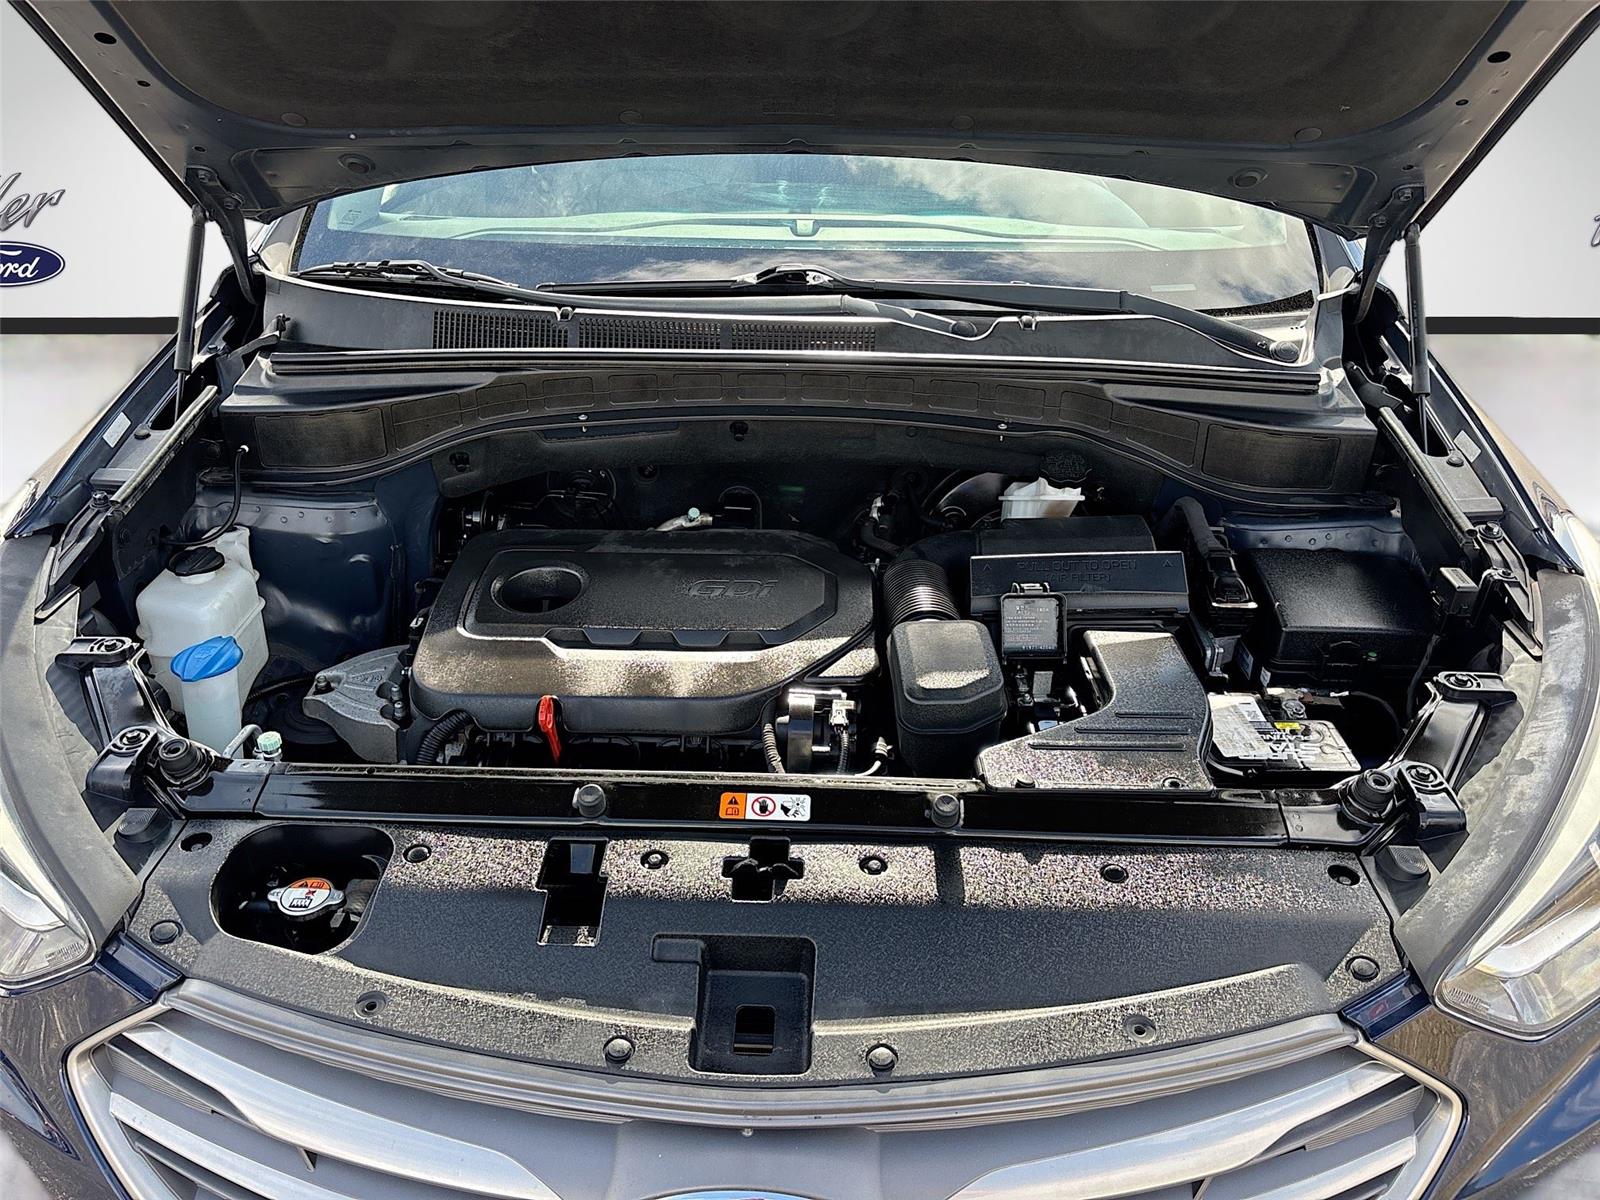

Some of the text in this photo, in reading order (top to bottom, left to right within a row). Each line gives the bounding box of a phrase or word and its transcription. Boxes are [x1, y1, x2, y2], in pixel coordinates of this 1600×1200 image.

[1016, 559, 1137, 571] PULL OUT TO OPEN
